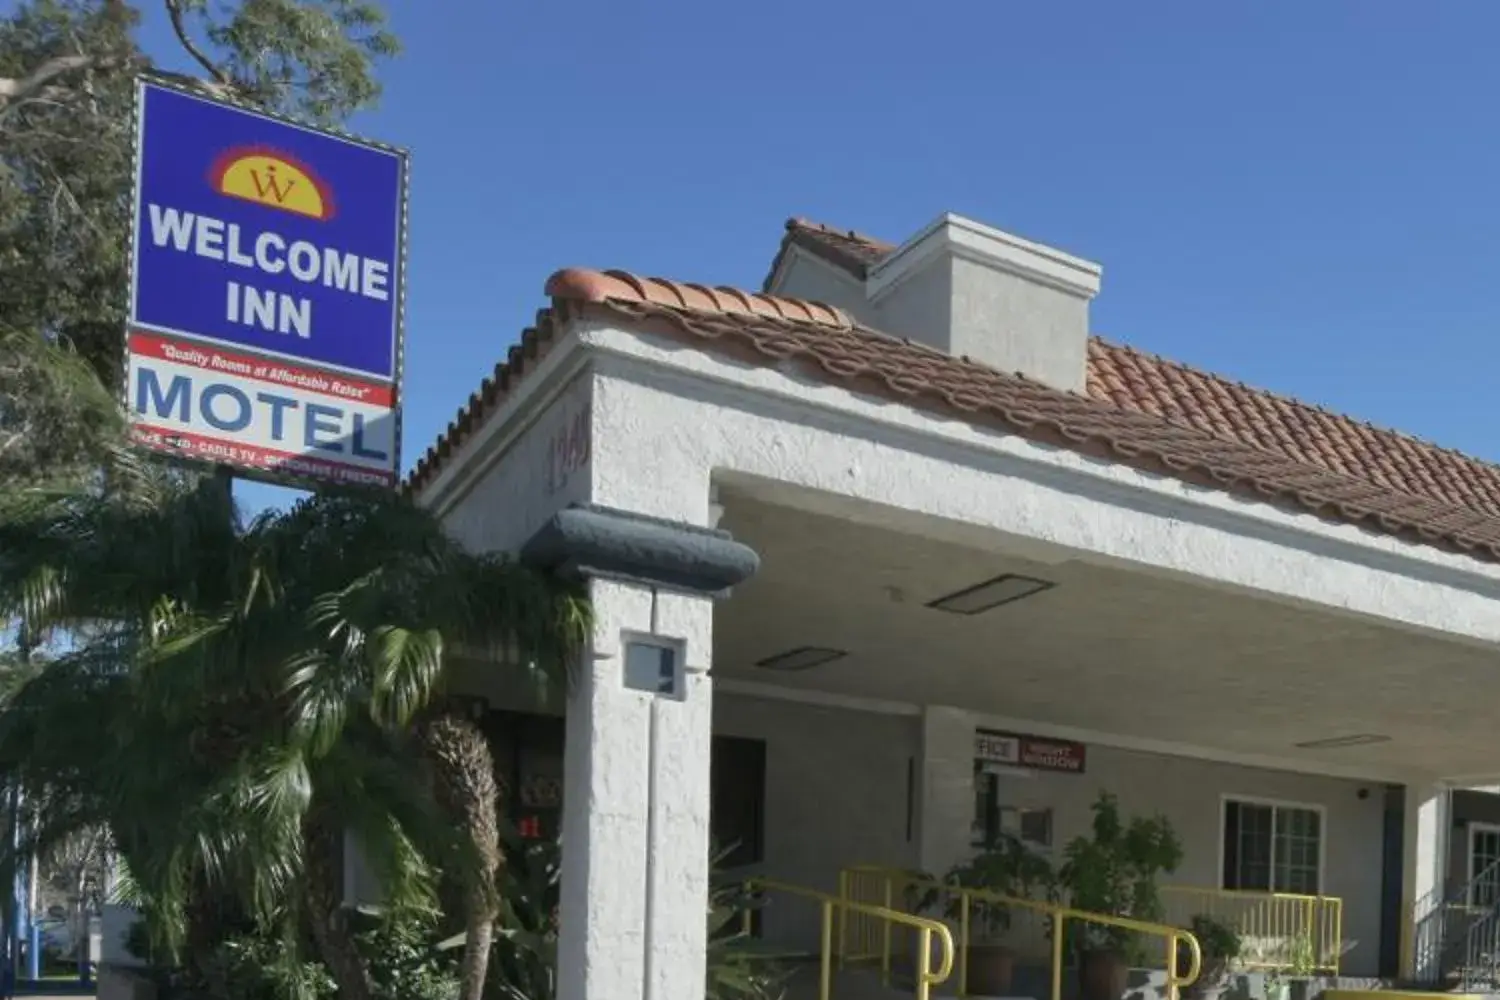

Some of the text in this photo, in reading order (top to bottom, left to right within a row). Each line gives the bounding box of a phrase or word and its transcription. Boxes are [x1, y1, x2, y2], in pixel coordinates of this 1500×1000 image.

[148, 204, 389, 301] WELCOME
[226, 281, 311, 339] INN
[211, 354, 252, 374] Rooms
[254, 363, 268, 378] at
[269, 367, 329, 391] Affordable
[136, 366, 389, 461] MOTEL
[199, 440, 237, 459] CABLE
[239, 449, 256, 462] TV
